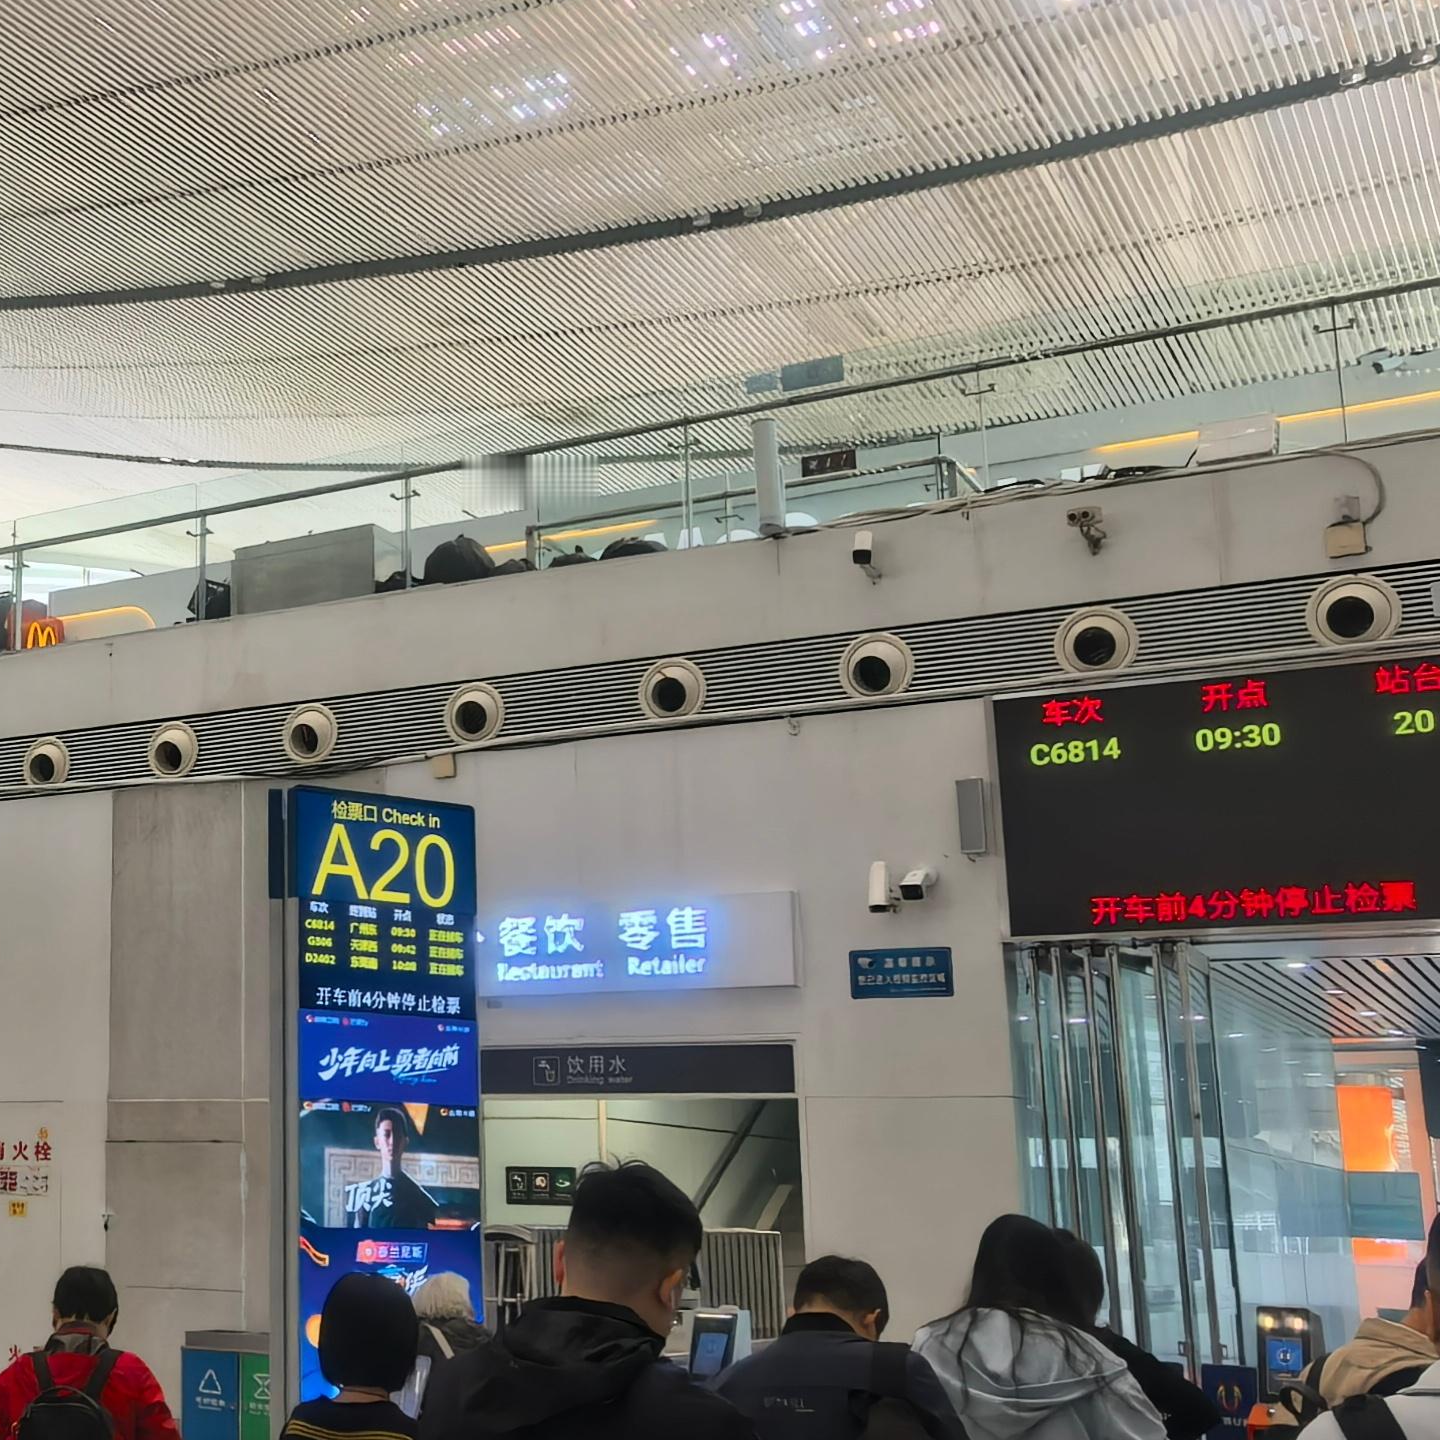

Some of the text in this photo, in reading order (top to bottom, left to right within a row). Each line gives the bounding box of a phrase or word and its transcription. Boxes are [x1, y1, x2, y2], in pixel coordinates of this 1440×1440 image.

[1043, 696, 1105, 728] 车次
[1202, 679, 1270, 714] 开点
[1030, 737, 1122, 767] C6814
[1195, 723, 1283, 753] 09:30
[1393, 709, 1436, 737] 20
[331, 799, 441, 829] 检票口 Check in
[311, 822, 456, 908] A20
[1091, 881, 1419, 927] 开车前4分钟停止检票
[498, 906, 709, 957] 餐饮 零售
[627, 953, 708, 976] Retailer
[315, 986, 462, 1014] 开车前4分钟停止检票
[566, 1054, 628, 1075] 饮用水
[344, 1177, 394, 1213] 顶尖
